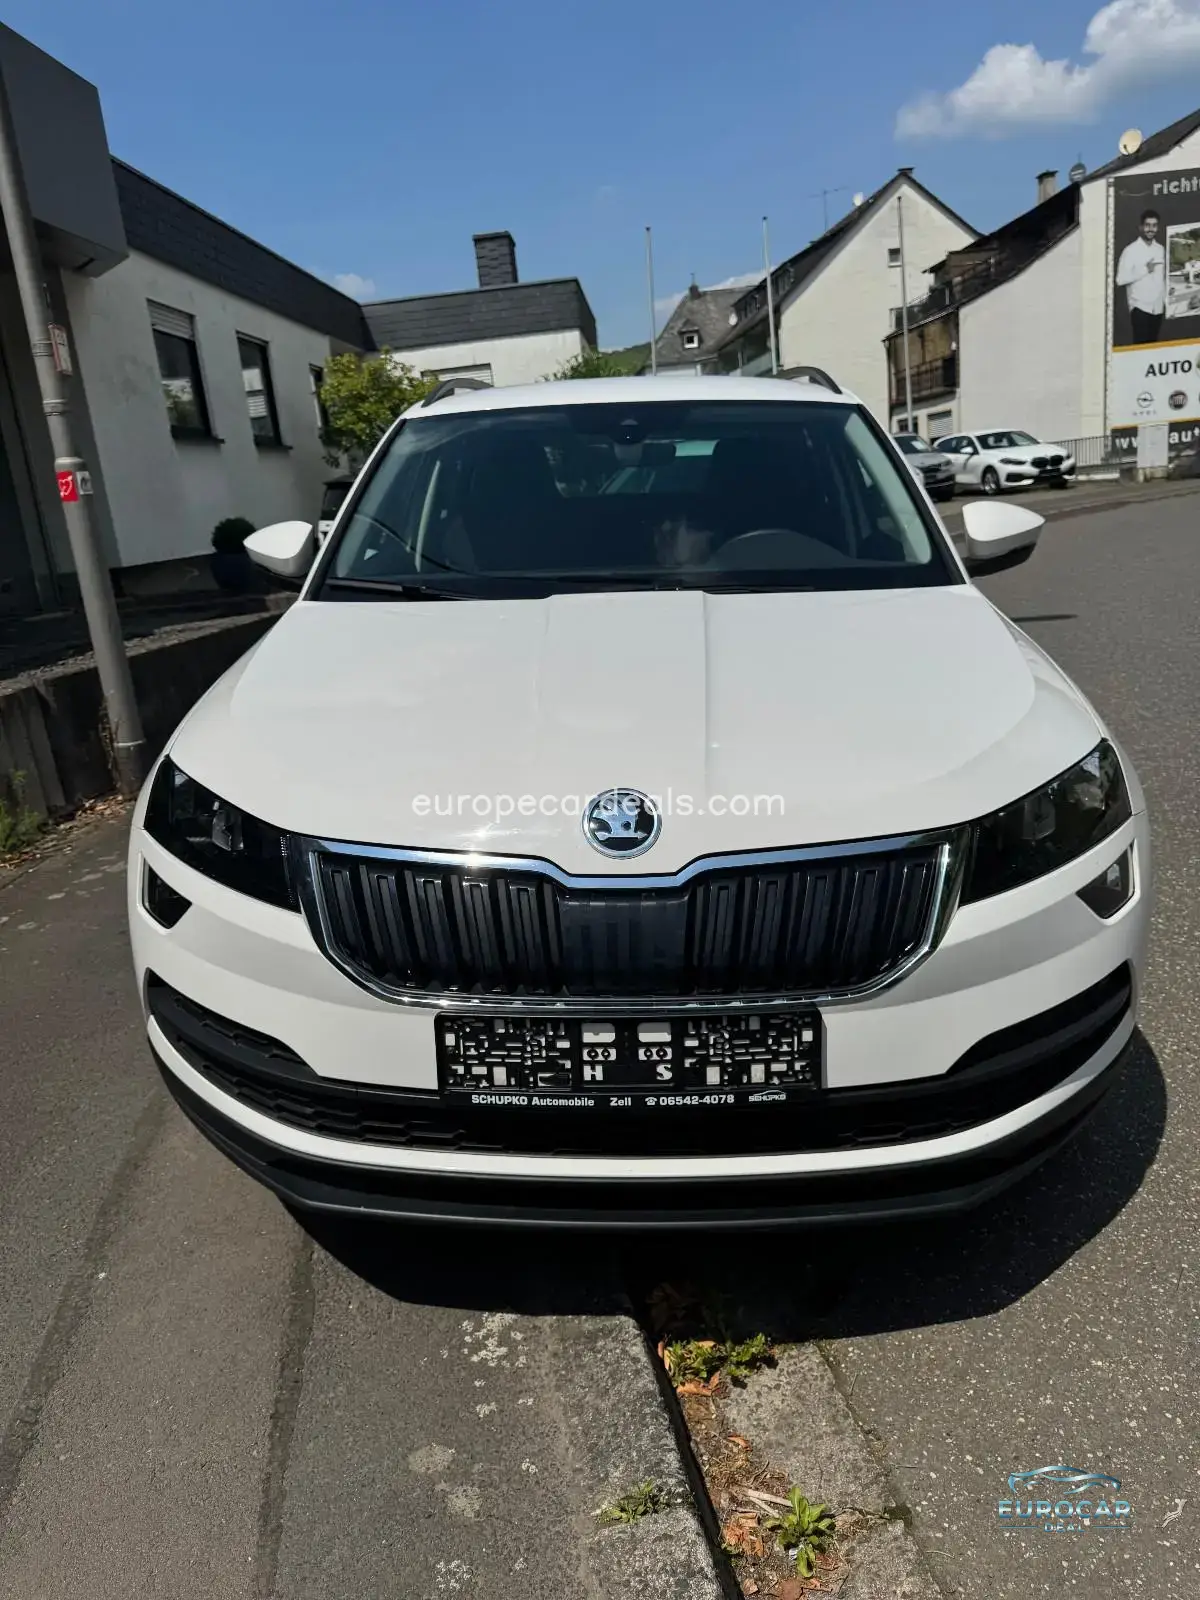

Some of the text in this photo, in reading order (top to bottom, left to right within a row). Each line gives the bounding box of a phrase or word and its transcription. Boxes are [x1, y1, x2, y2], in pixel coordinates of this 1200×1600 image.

[1152, 176, 1200, 196] richt
[1145, 359, 1192, 378] AUTO
[471, 1094, 528, 1106] SCHUPKO
[531, 1096, 595, 1107] Automobile
[610, 1097, 632, 1107] Zell
[659, 1094, 735, 1106] 06542-4078
